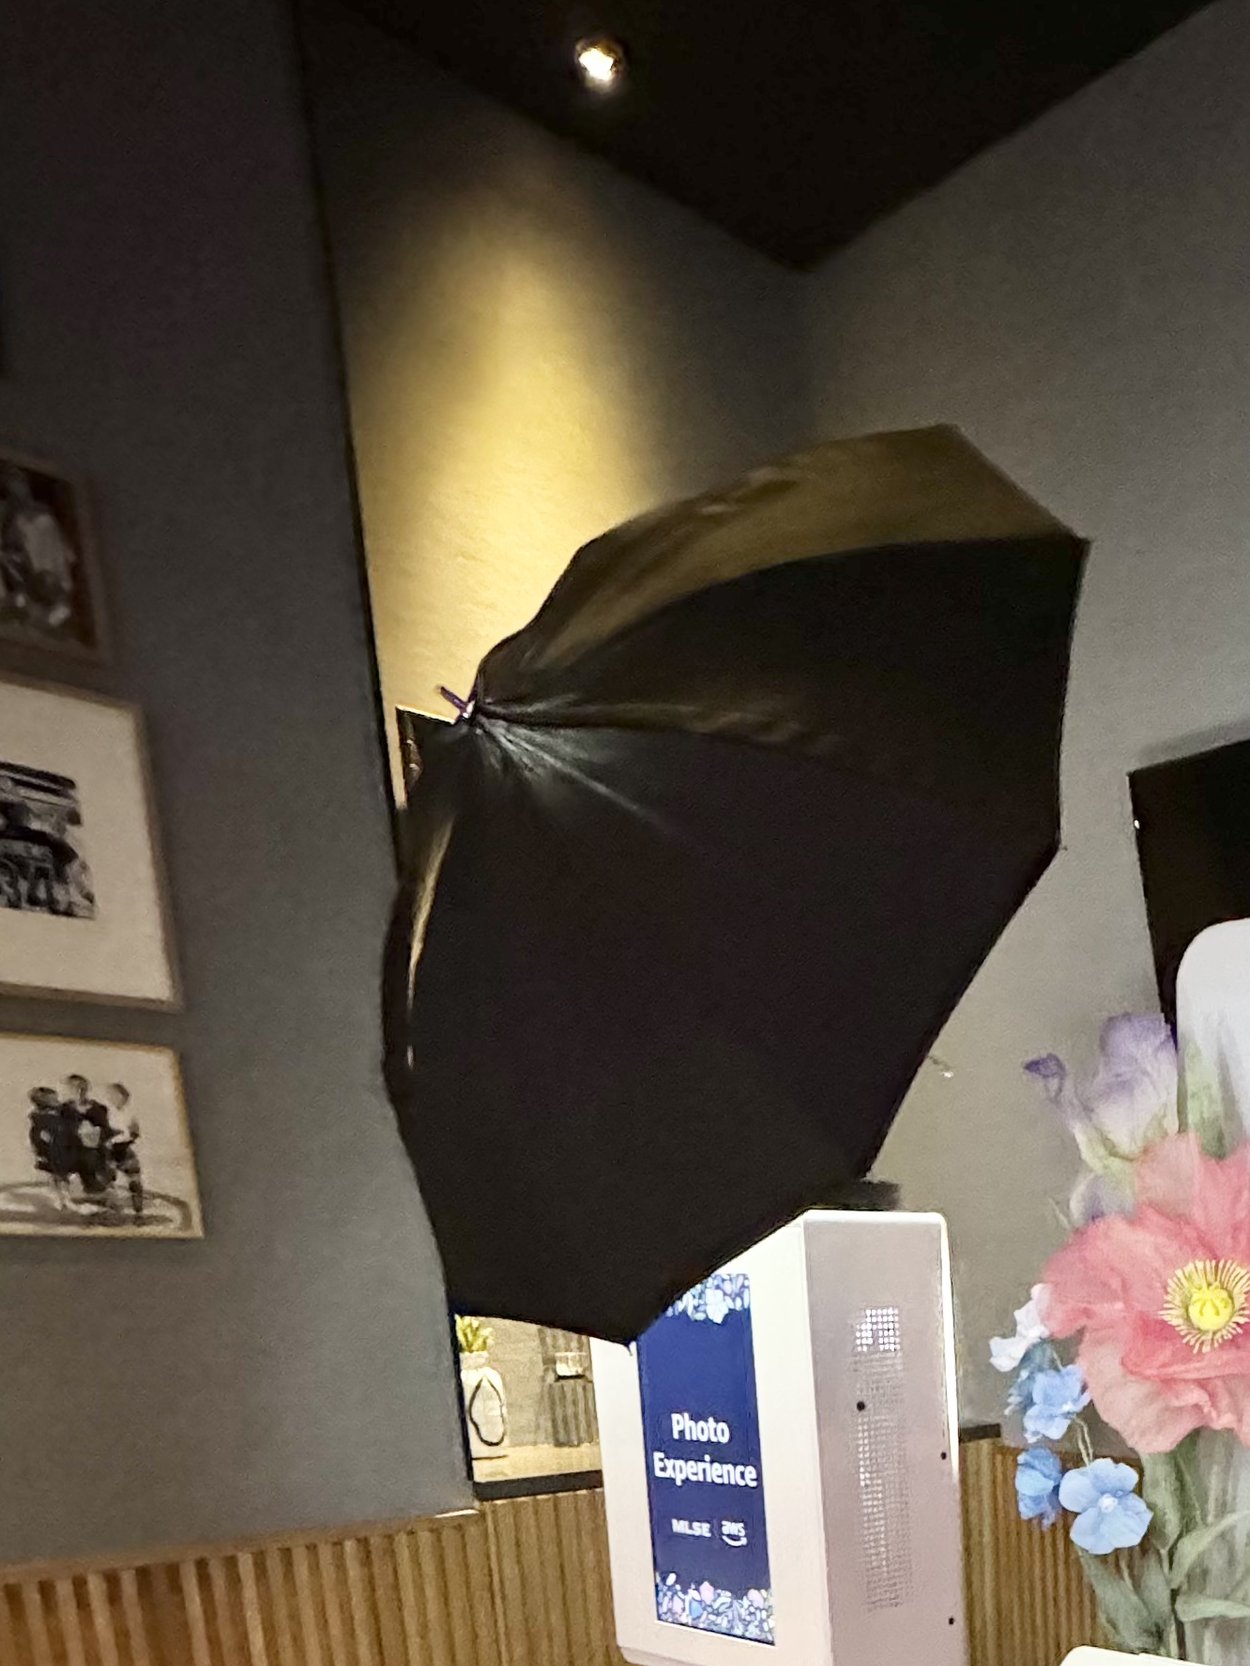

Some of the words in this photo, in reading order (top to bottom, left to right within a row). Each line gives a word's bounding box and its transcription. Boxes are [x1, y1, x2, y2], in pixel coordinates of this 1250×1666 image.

[671, 1412, 730, 1443] Photo
[653, 1451, 757, 1487] Experience
[671, 1518, 711, 1537] MLSE
[721, 1520, 745, 1536] aws
